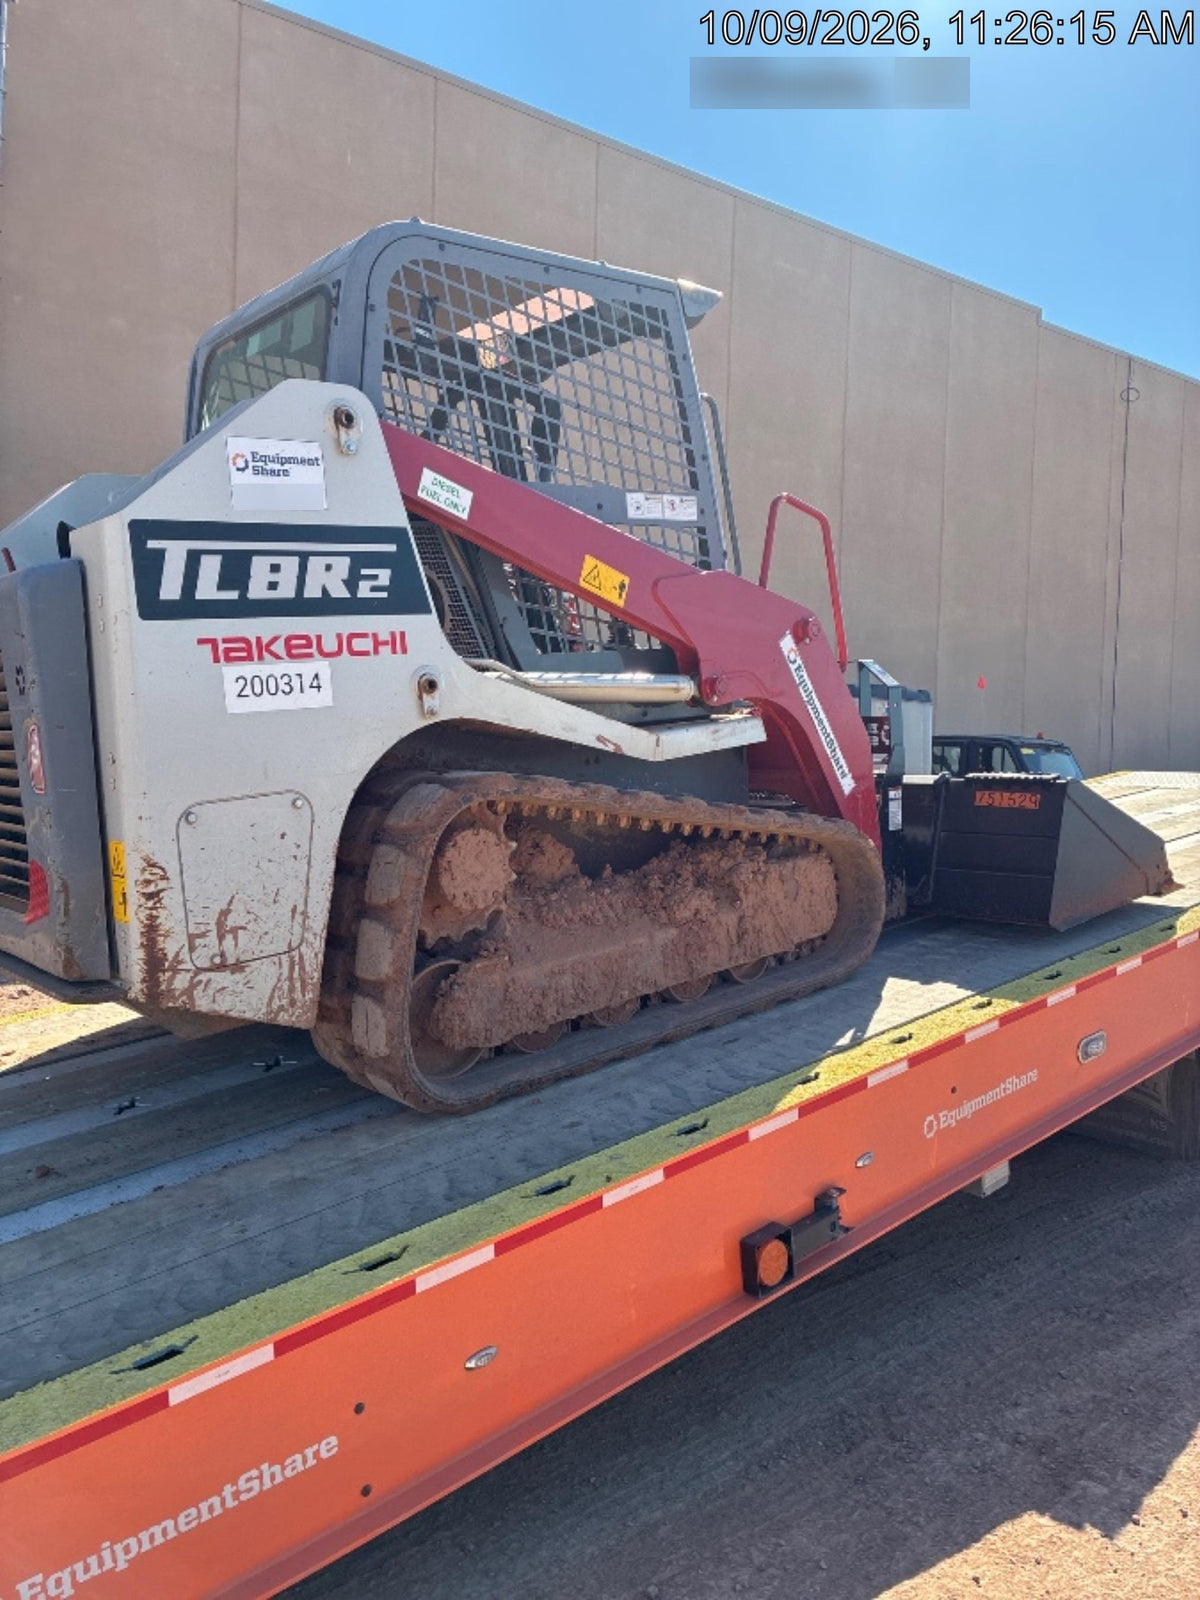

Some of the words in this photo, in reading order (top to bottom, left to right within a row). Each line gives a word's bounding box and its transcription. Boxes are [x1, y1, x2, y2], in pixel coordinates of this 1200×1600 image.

[250, 451, 321, 467] Equipment
[252, 465, 291, 477] Share
[420, 485, 442, 504] FUEL
[431, 477, 460, 499] DIESEL
[235, 672, 322, 698] 200314
[793, 663, 849, 780] EquipmentShare
[939, 1069, 1038, 1128] EquipmentShare
[15, 1435, 339, 1600] EquipmentShare
